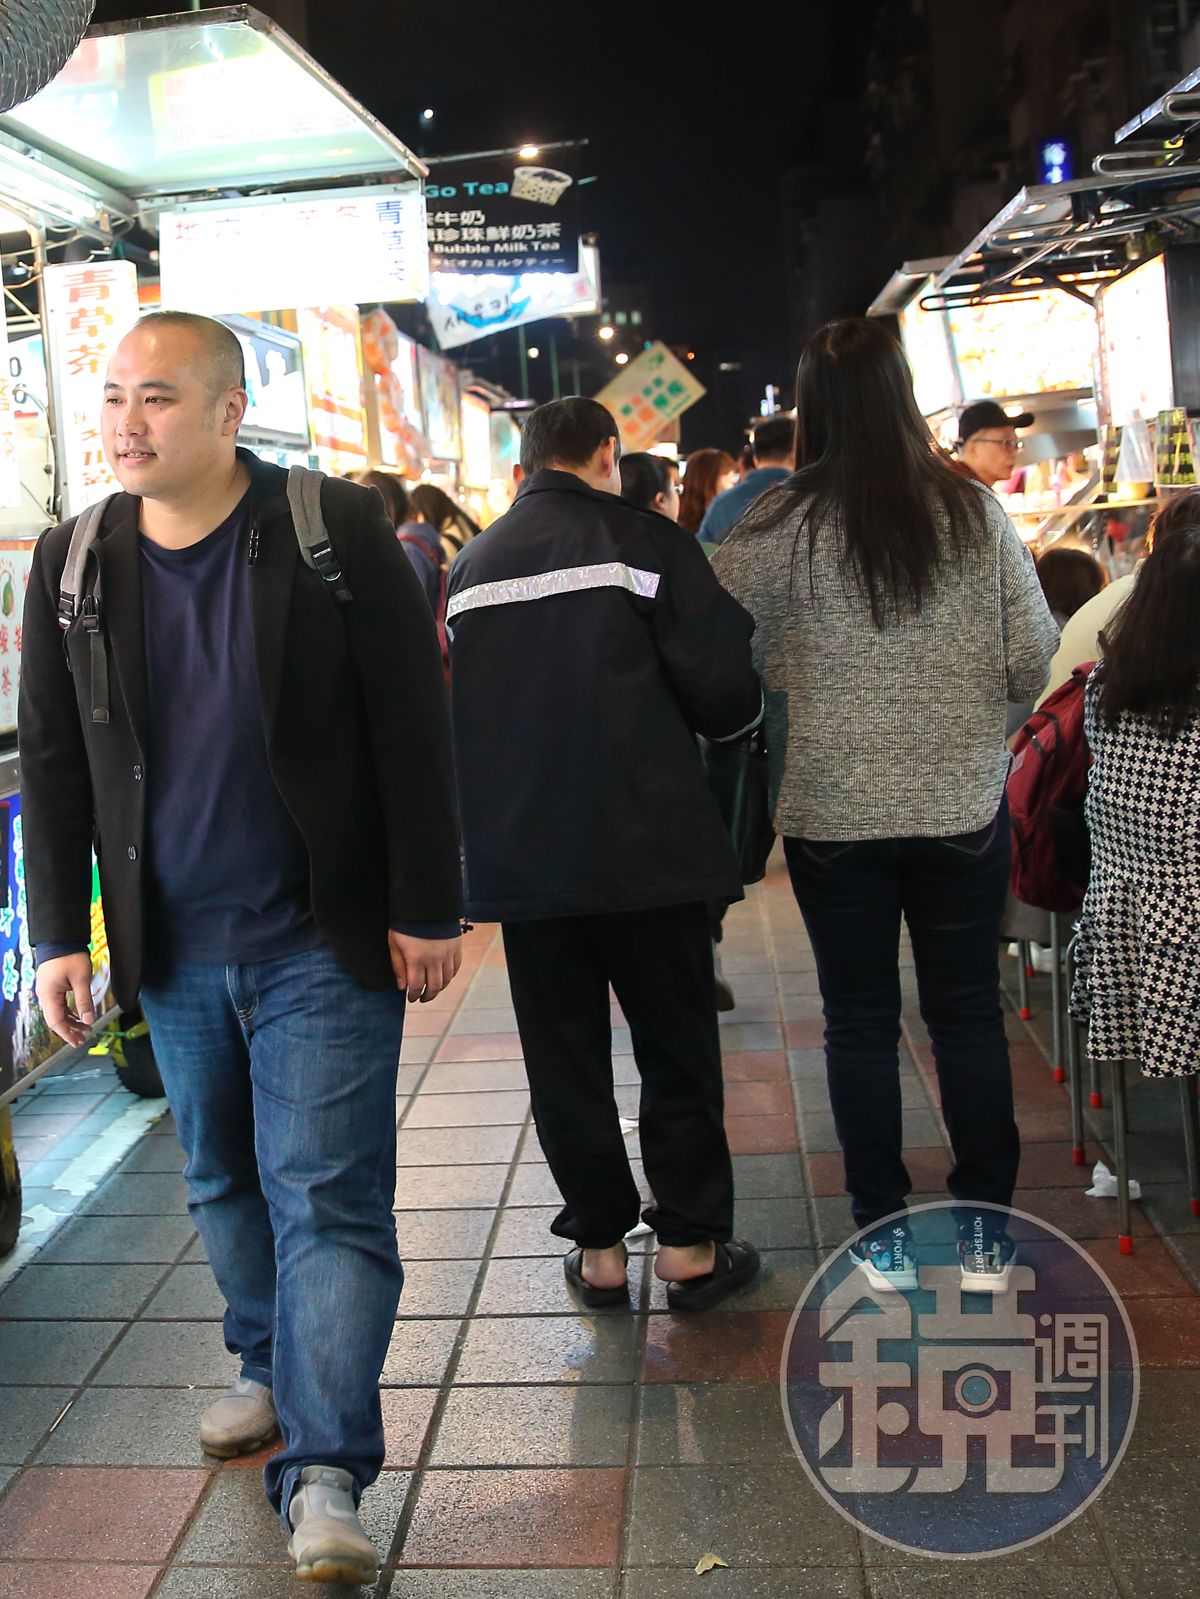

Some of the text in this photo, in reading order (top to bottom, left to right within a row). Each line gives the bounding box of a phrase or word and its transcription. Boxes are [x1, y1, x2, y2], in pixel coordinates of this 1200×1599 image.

[462, 181, 510, 196] Tea
[433, 240, 561, 255] Bubble Milk Tea
